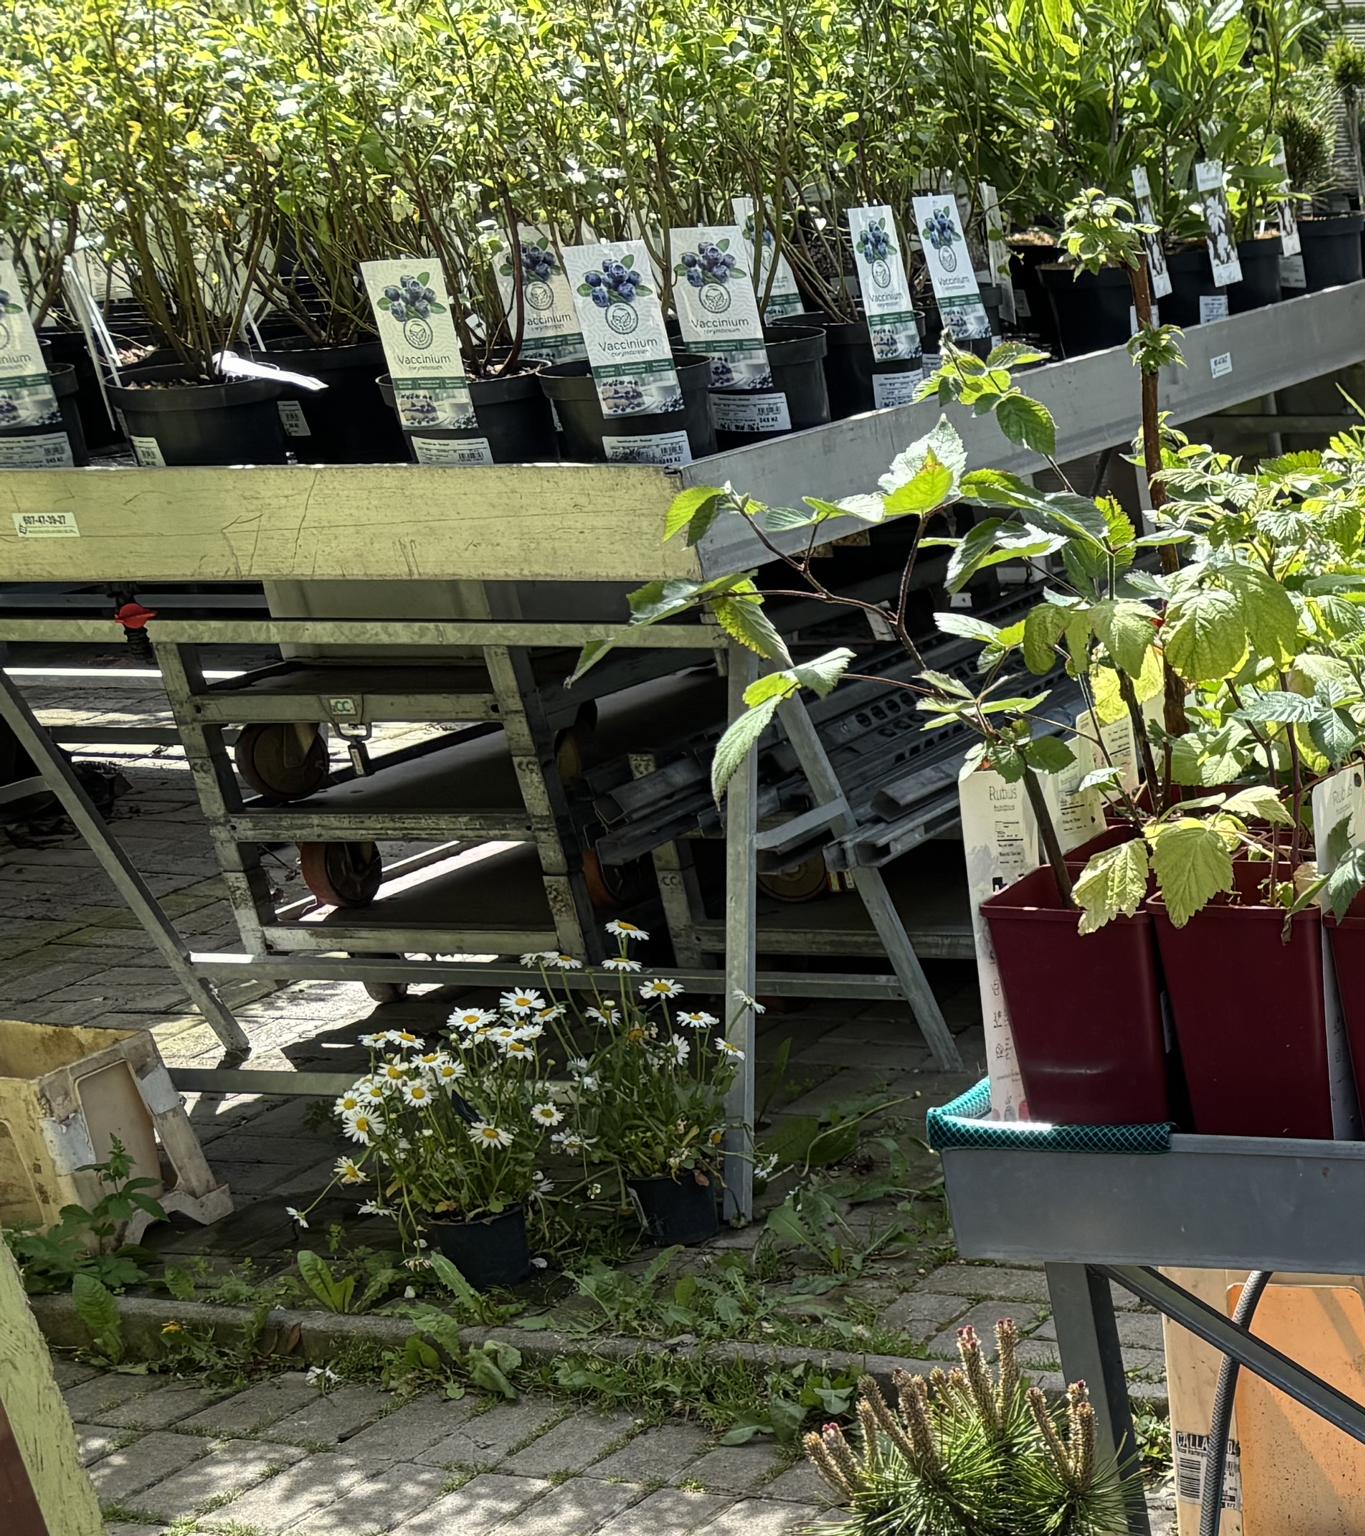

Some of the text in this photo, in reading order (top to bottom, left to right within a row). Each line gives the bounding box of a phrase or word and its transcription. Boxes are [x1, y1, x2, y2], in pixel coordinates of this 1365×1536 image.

[527, 313, 572, 326] accinium
[690, 318, 750, 330] Vaccinium
[598, 337, 658, 353] Vaccinium
[397, 353, 452, 366] Vaccinium
[336, 700, 350, 712] CC
[989, 785, 1018, 801] Rubus
[1176, 1432, 1209, 1454] CALLA
